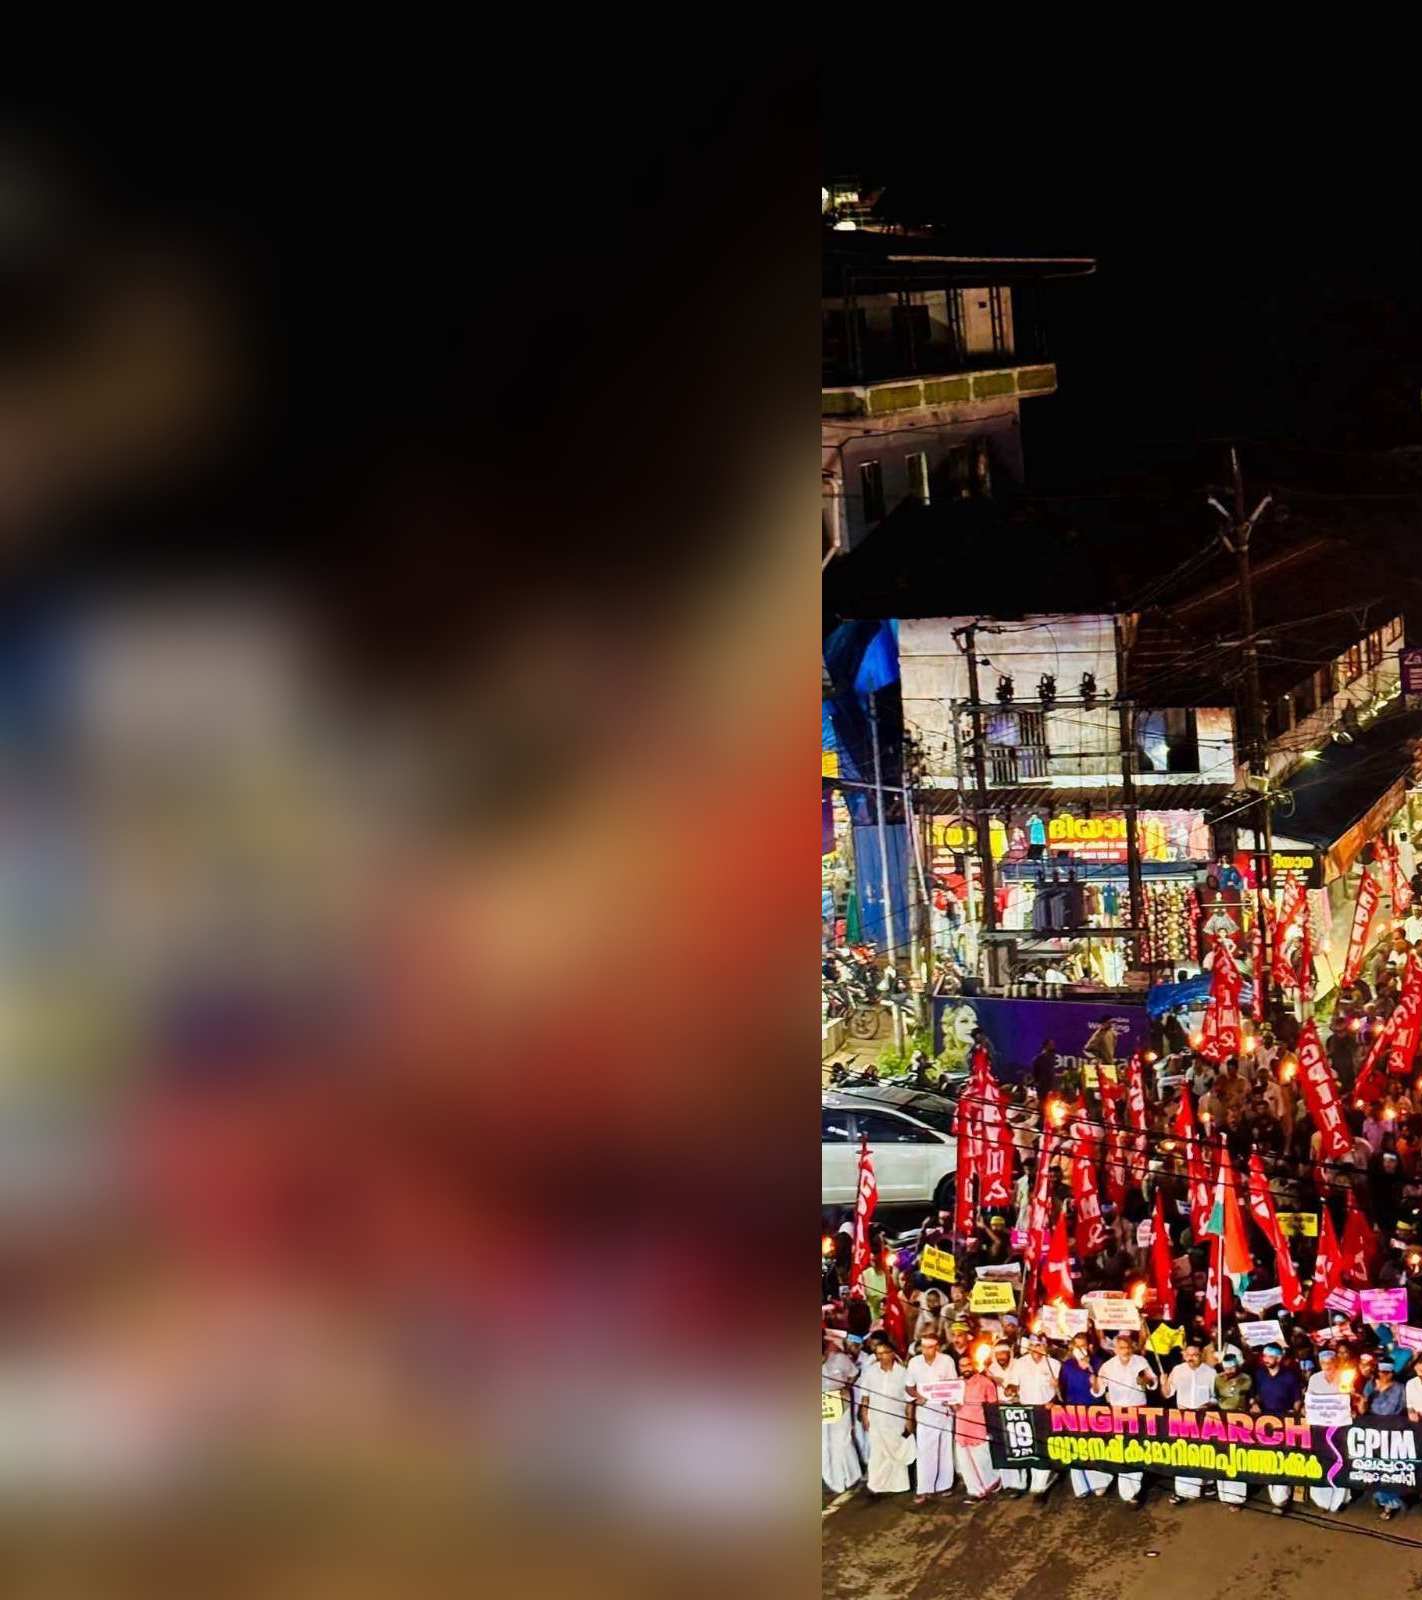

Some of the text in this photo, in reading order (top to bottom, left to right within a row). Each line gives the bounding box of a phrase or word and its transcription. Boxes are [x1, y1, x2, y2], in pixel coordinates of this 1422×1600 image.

[1049, 811, 1127, 839] ദിയാ
[1301, 1043, 1341, 1131] CPIM
[1006, 1421, 1034, 1448] 19
[1051, 1405, 1163, 1436] NIGHT
[1168, 1408, 1312, 1449] MARCH
[1346, 1427, 1417, 1460] CPIM
